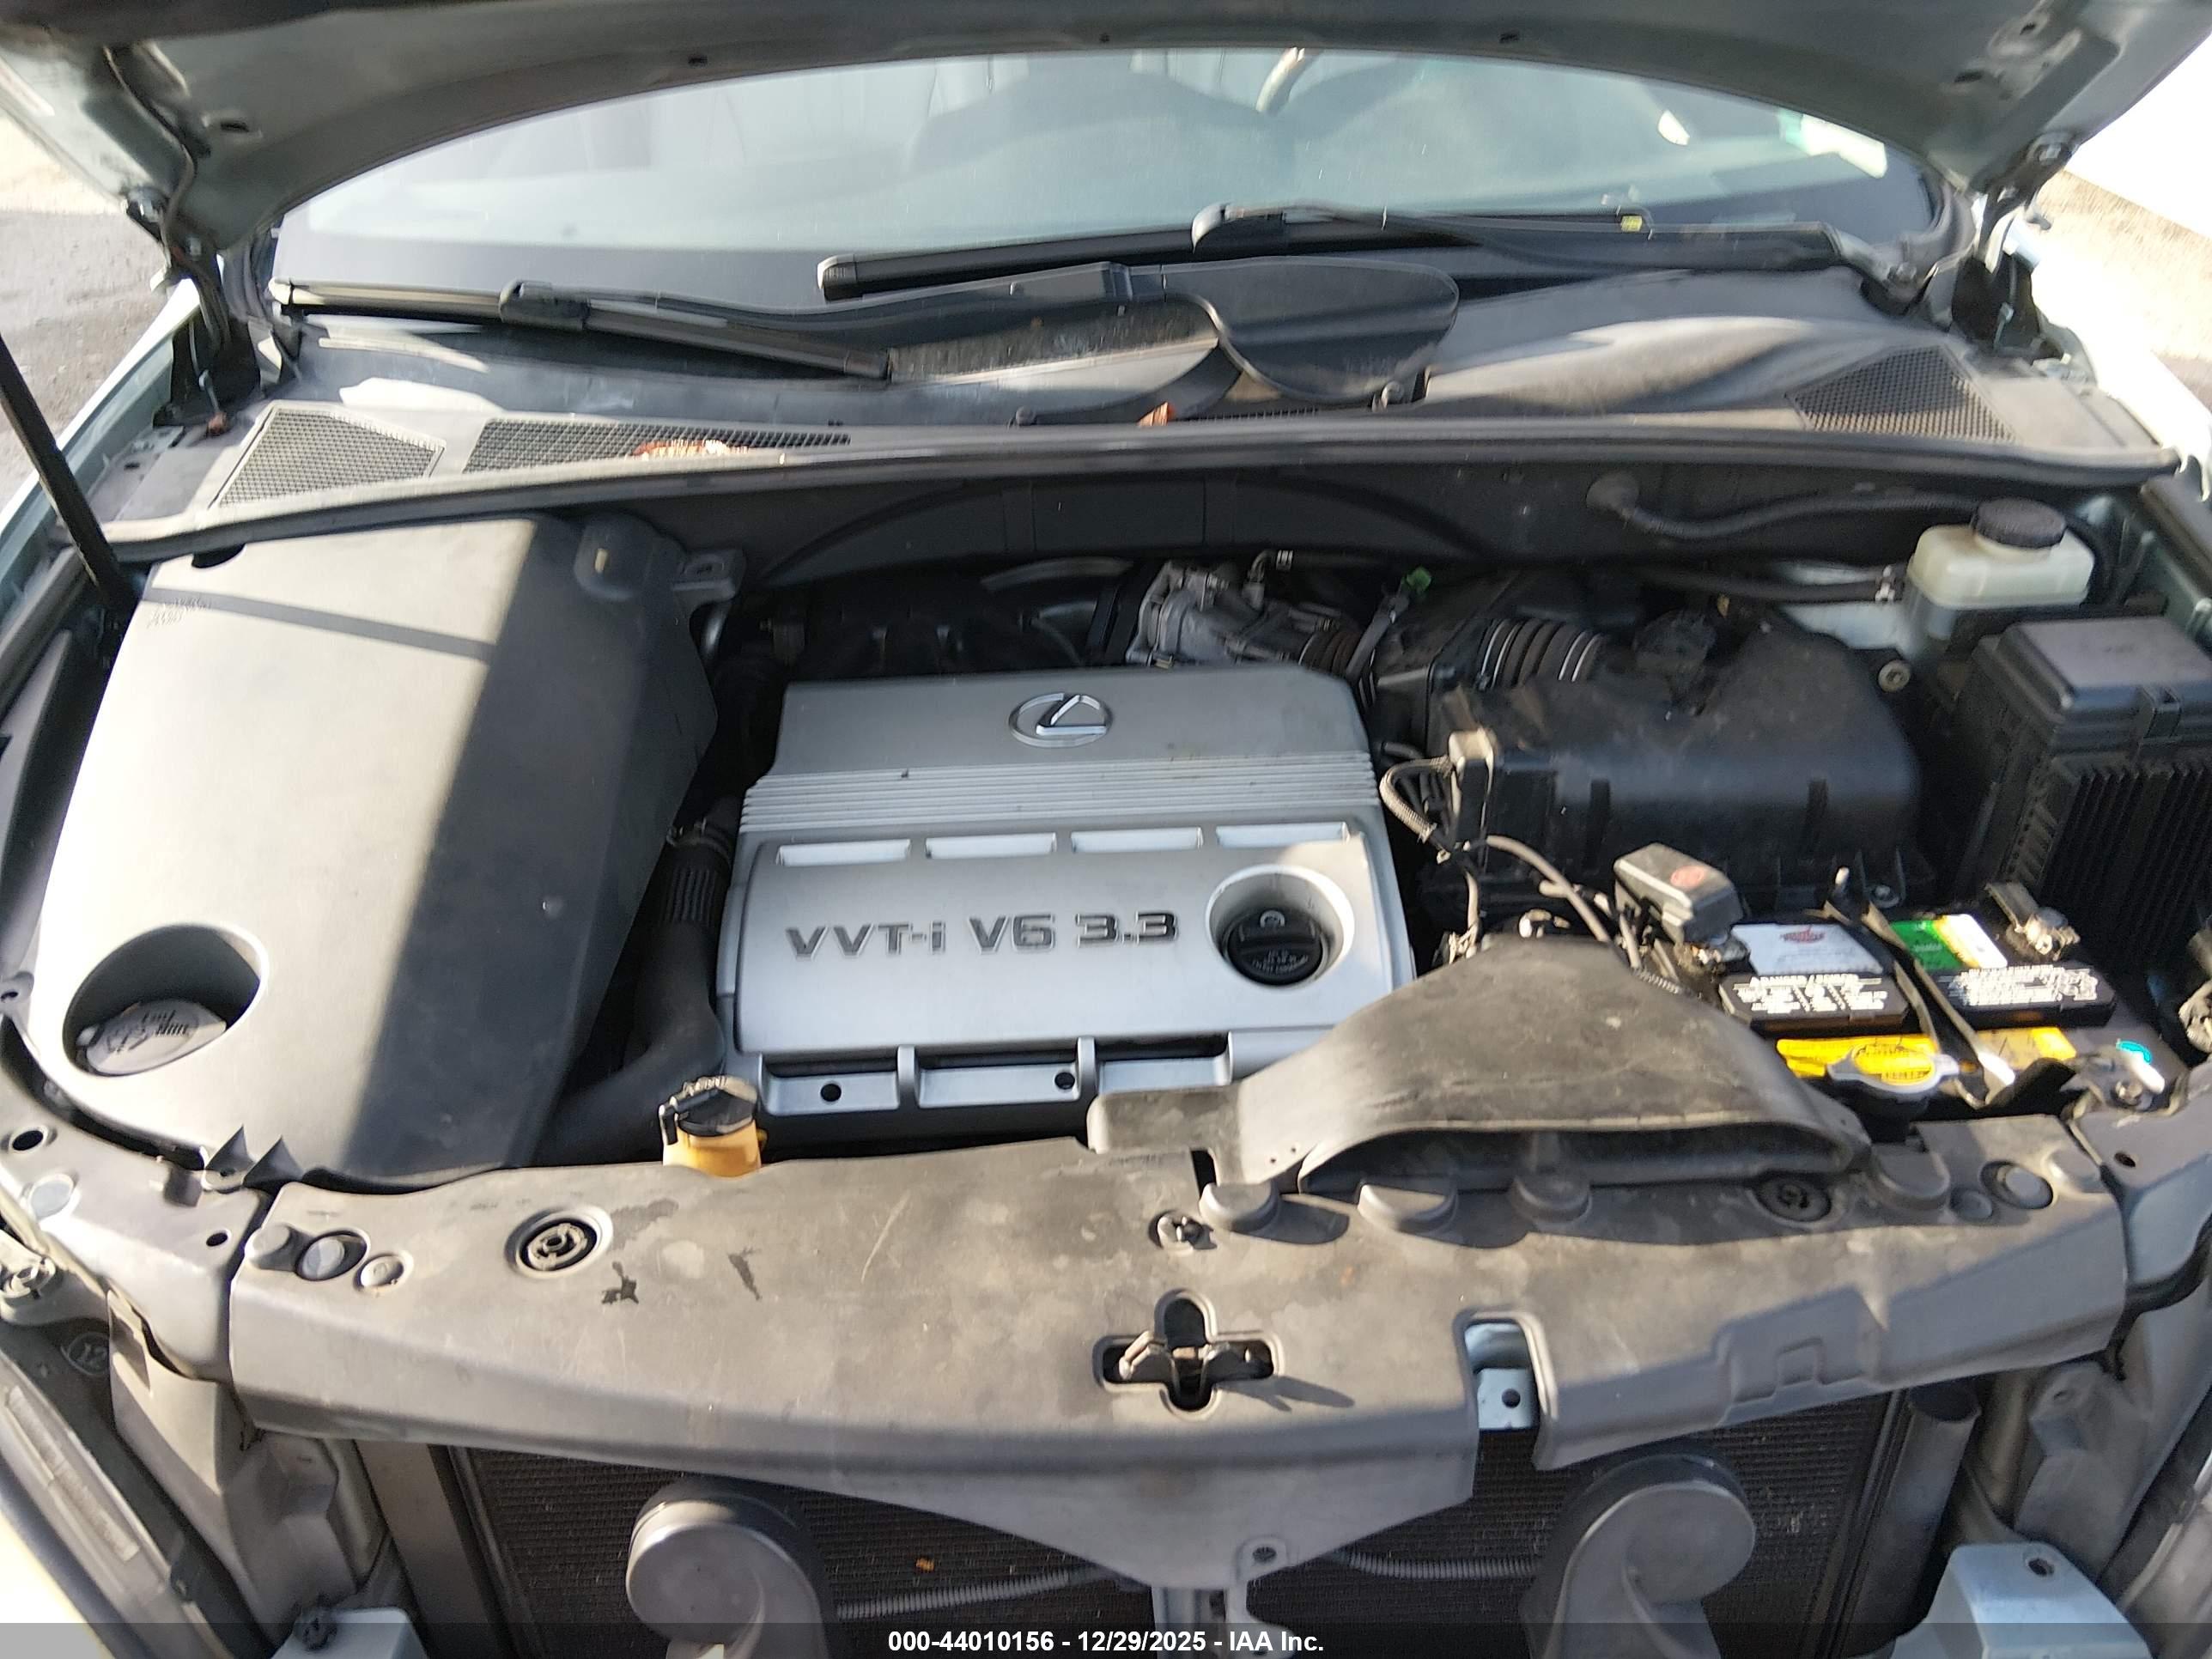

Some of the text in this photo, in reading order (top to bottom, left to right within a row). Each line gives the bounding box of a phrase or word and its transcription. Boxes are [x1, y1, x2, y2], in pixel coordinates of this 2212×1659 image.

[785, 910, 1178, 960] VVT-i V6 3.3
